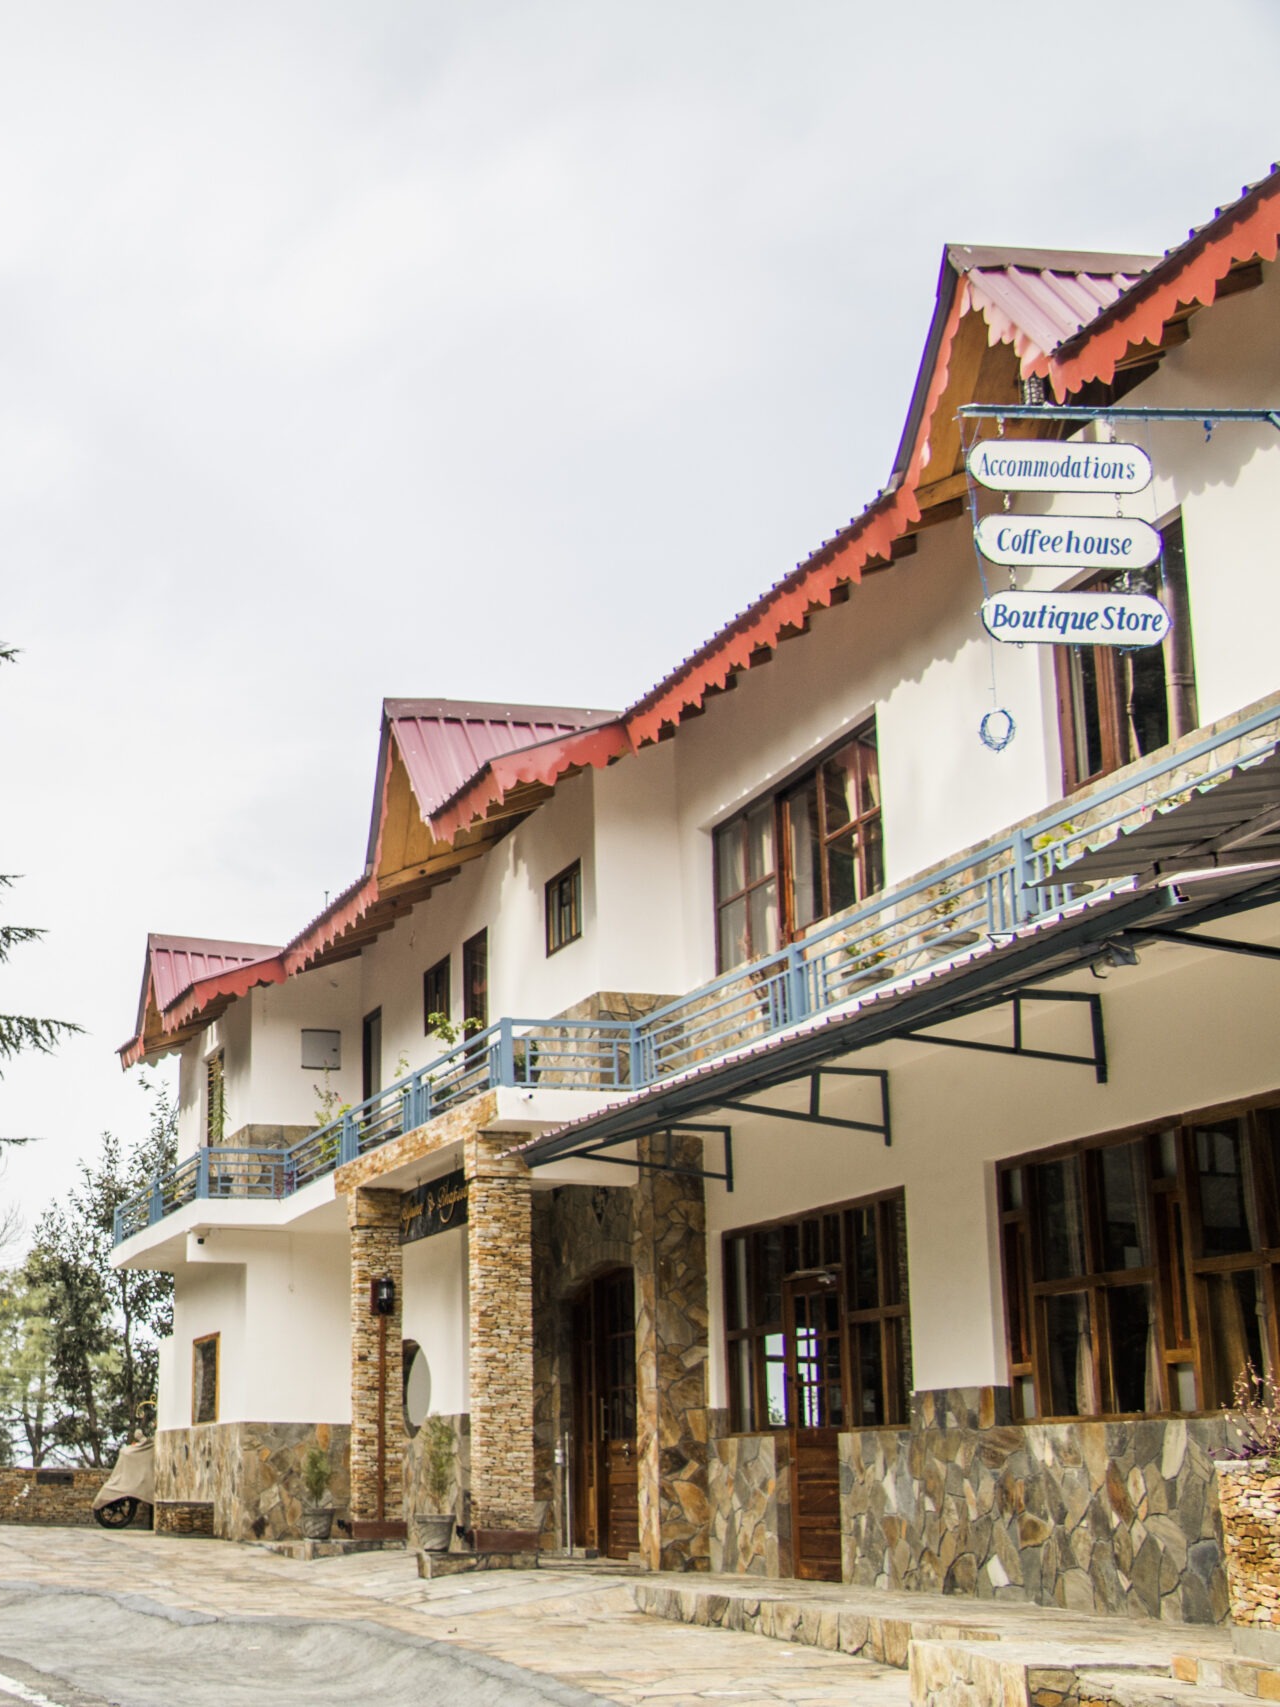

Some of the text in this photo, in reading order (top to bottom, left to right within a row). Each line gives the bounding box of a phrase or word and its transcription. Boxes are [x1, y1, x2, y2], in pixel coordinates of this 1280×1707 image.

[978, 453, 1136, 480] Accommodations
[992, 604, 1163, 635] Boutique Store
